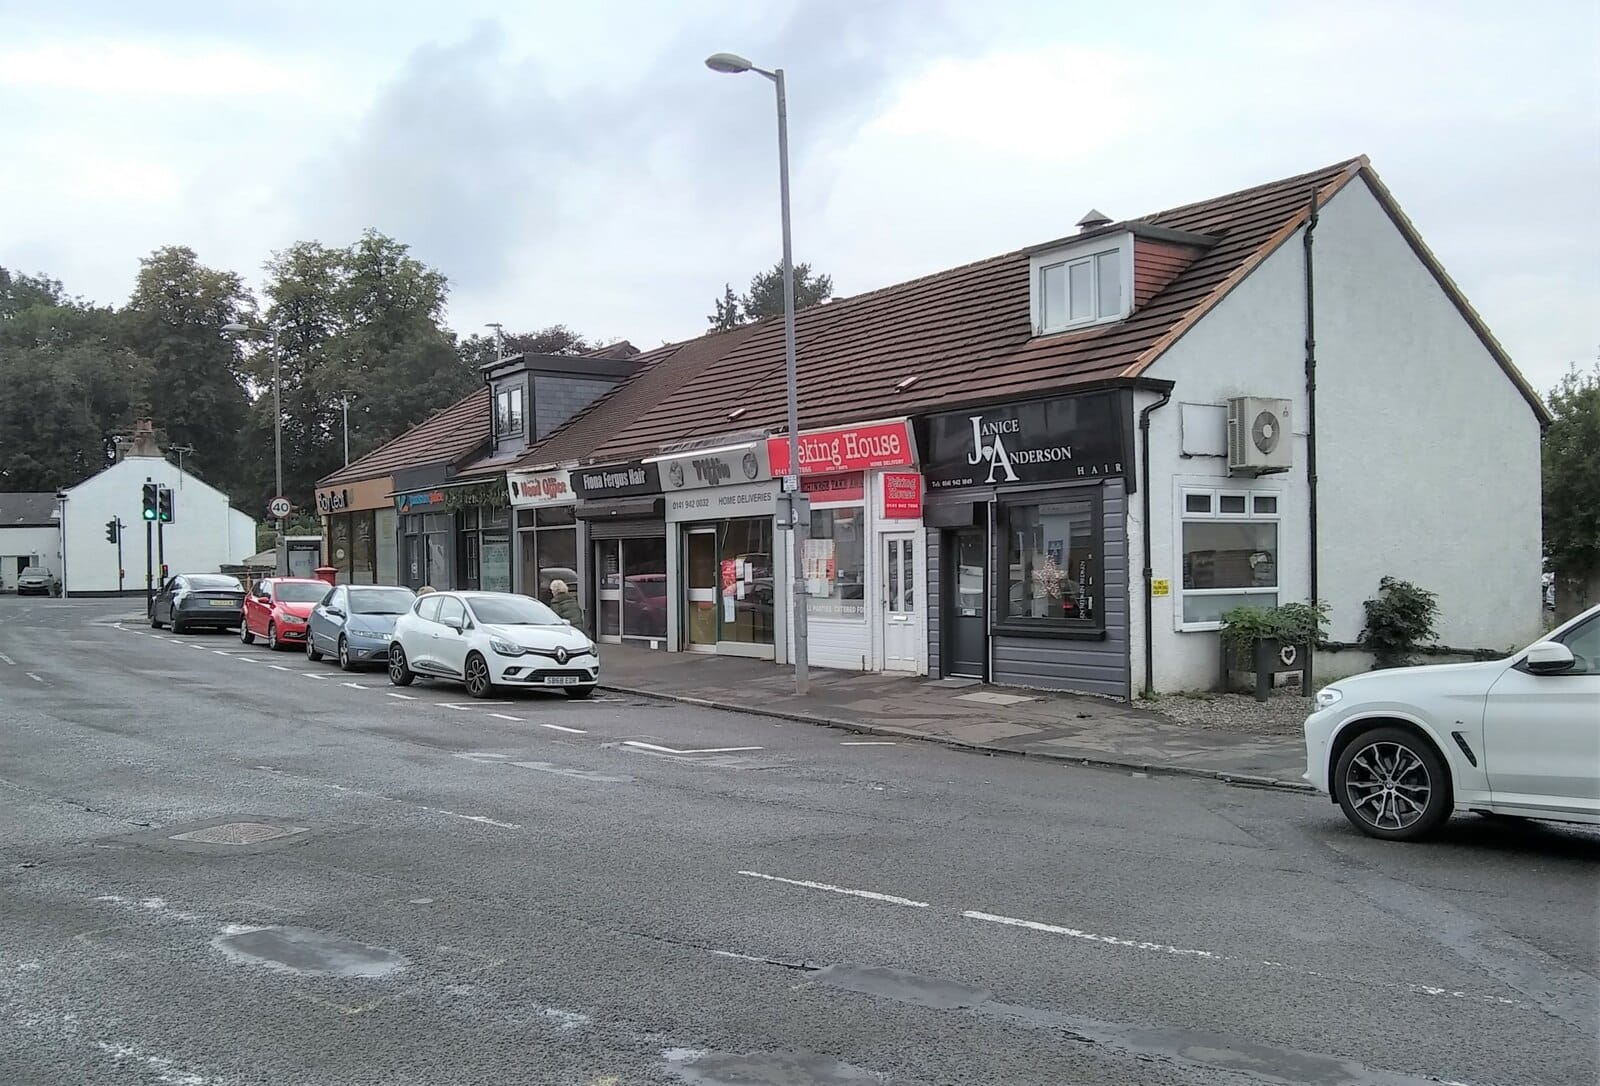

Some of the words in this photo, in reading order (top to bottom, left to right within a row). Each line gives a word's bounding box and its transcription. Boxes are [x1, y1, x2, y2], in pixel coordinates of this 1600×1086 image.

[843, 433, 900, 459] House
[1077, 463, 1122, 475] HAIR
[582, 473, 603, 490] Fiona
[603, 471, 629, 489] Fergus
[629, 468, 646, 485] Hair
[272, 502, 289, 512] 40
[672, 500, 684, 510] 0141
[686, 500, 695, 508] 942
[719, 495, 736, 506] HOME
[737, 492, 772, 504] DELIVERIES
